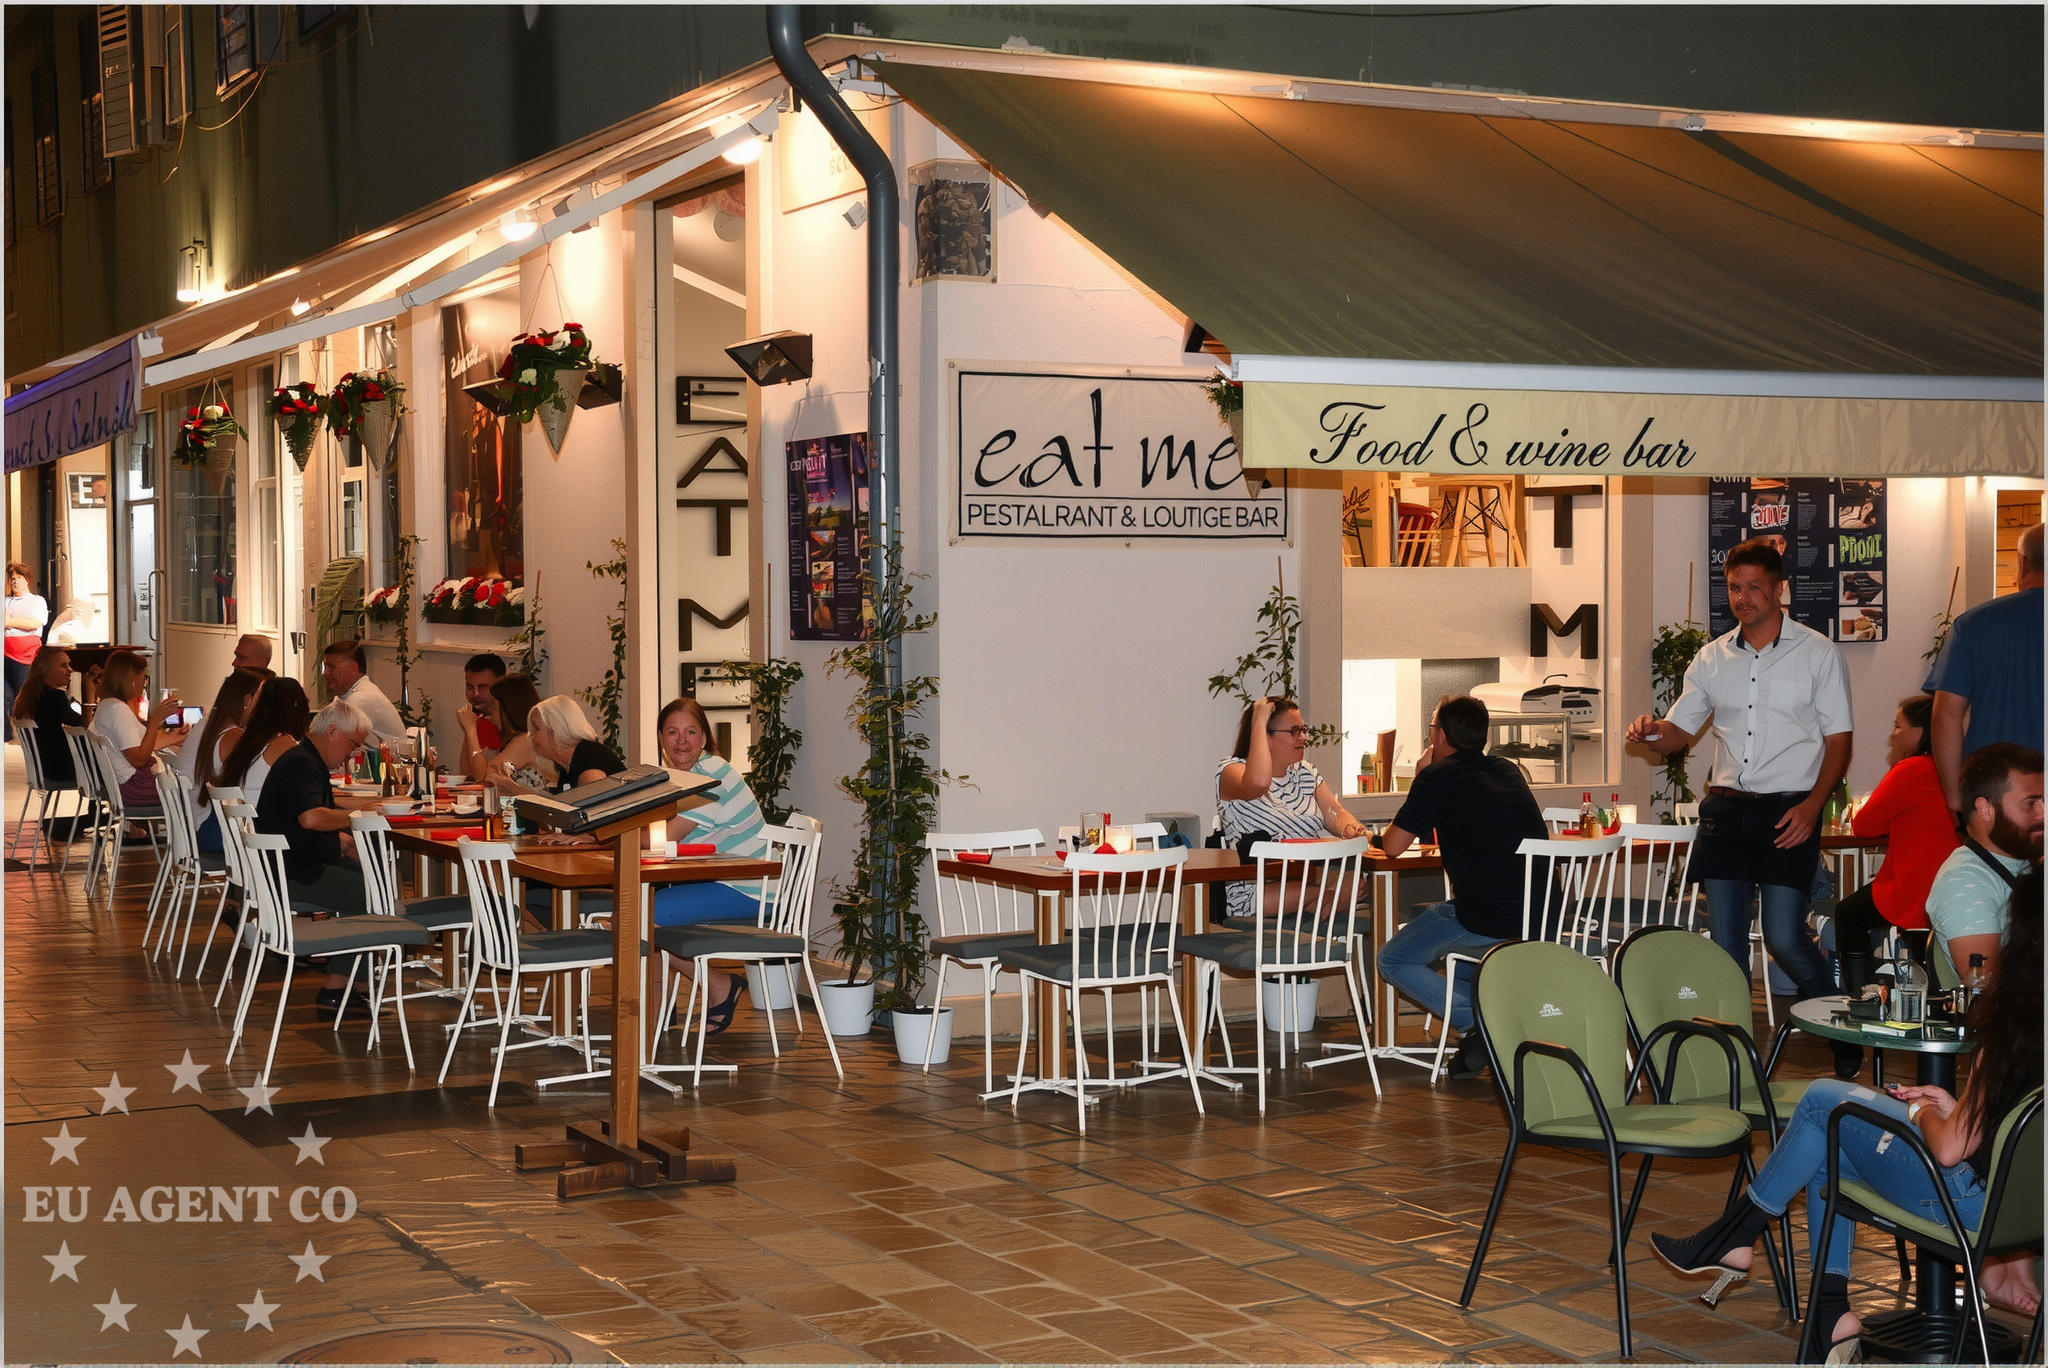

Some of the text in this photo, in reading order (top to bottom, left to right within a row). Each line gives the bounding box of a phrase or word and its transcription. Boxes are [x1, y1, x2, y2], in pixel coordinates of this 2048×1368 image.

[975, 388, 1113, 488] eat
[1309, 401, 1697, 469] Food & wine bar
[1121, 505, 1136, 527] &
[1236, 506, 1278, 528] BAR
